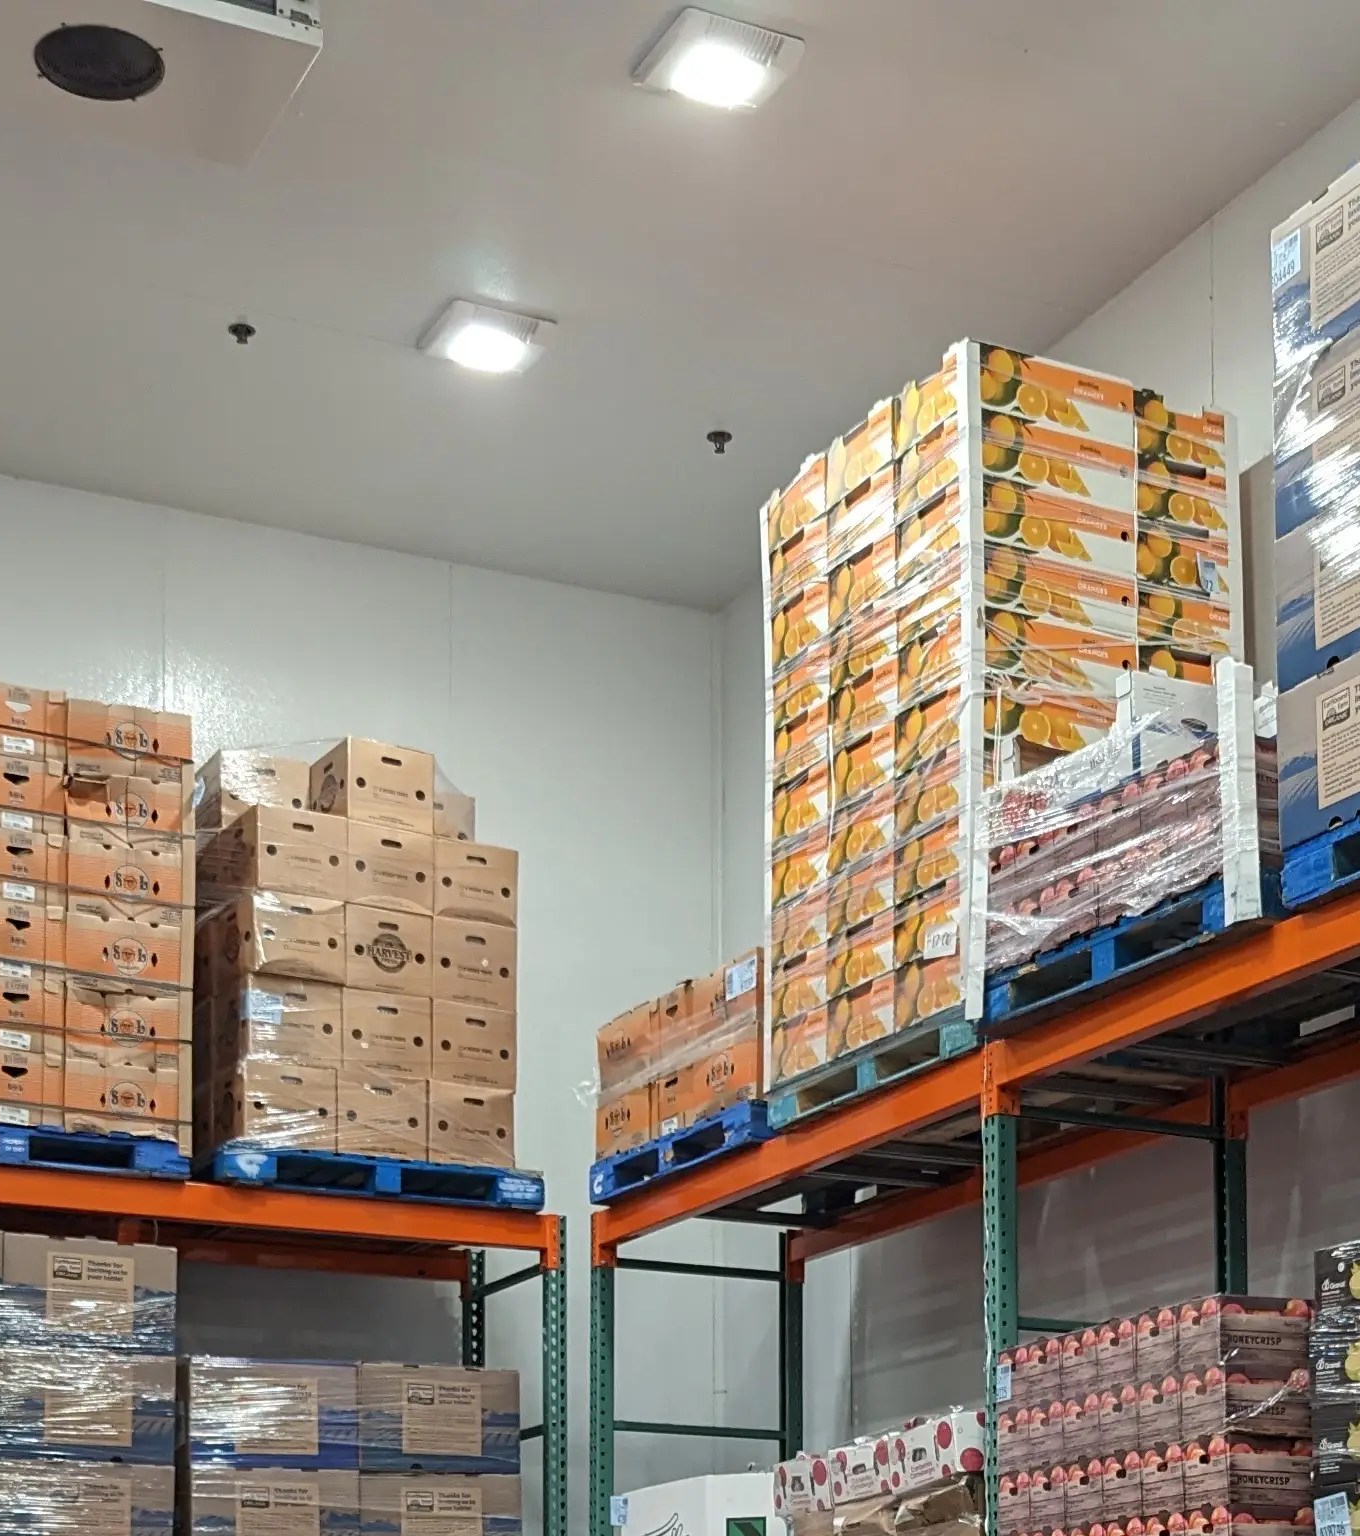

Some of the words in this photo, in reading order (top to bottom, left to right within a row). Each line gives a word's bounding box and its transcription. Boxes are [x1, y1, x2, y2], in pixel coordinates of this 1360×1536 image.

[366, 943, 413, 964] HARVEST
[1228, 1335, 1282, 1347] HONEYCRISP
[1237, 1475, 1290, 1487] HONEYCRISP
